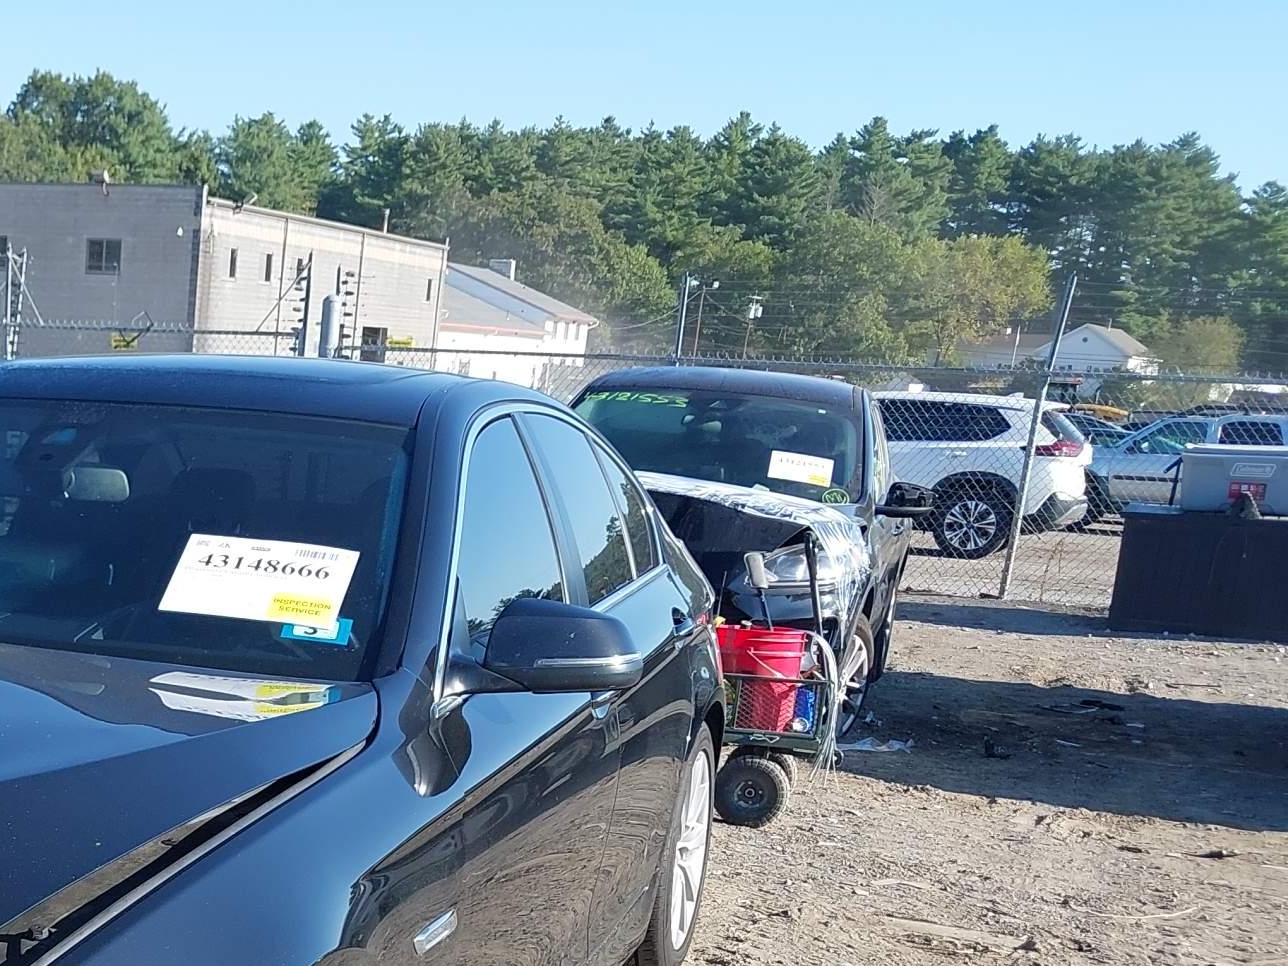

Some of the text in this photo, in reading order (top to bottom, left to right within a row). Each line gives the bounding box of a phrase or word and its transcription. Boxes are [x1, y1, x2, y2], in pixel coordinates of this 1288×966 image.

[198, 553, 330, 580] 43148666
[273, 598, 331, 610] INSPECTION
[278, 605, 321, 616] SERVICE
